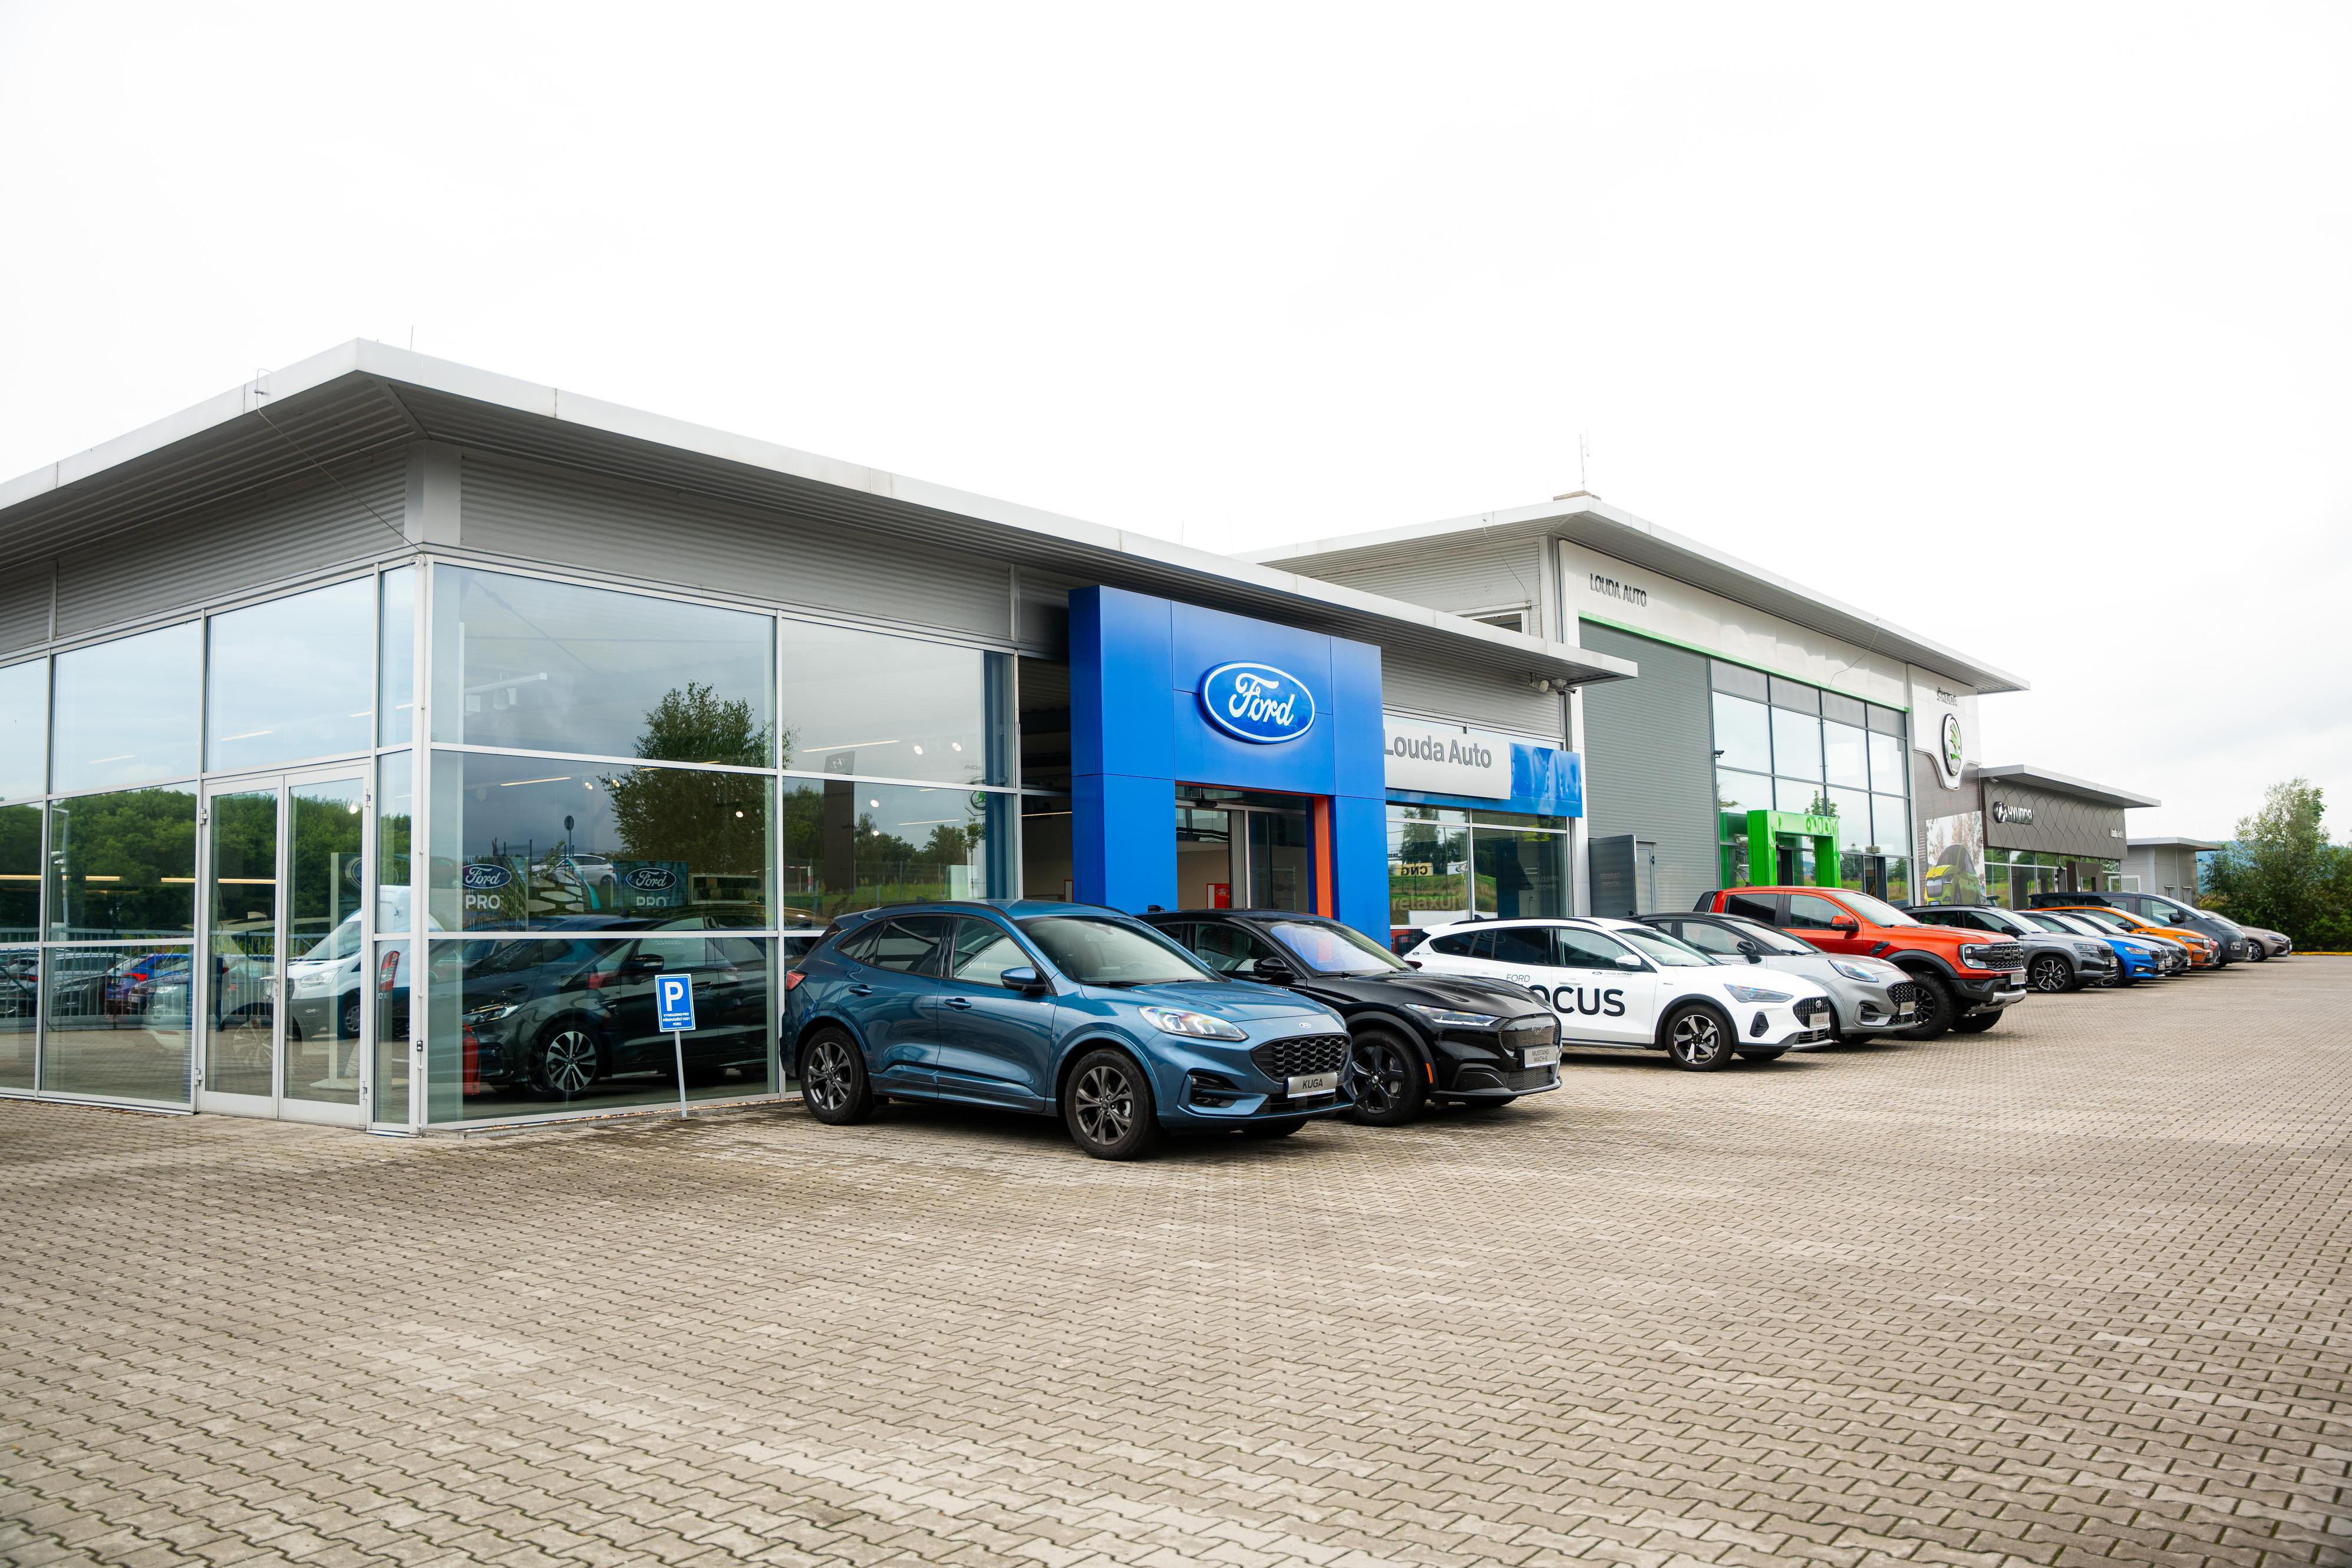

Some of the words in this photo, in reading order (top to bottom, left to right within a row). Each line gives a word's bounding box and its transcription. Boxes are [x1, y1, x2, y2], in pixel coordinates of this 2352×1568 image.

[1590, 573, 1621, 599] LOUDA
[1624, 585, 1647, 607] AUTO
[1229, 673, 1295, 726] Ford
[1383, 729, 1444, 762] Louda
[1449, 739, 1492, 768] Auto
[465, 867, 501, 884] Ford
[636, 870, 667, 886] Ford
[466, 894, 500, 909] PRO
[1506, 974, 1530, 982] FORD
[665, 981, 684, 1012] P
[1528, 985, 1625, 1017] OCUS
[1302, 1078, 1323, 1090] KUGA
